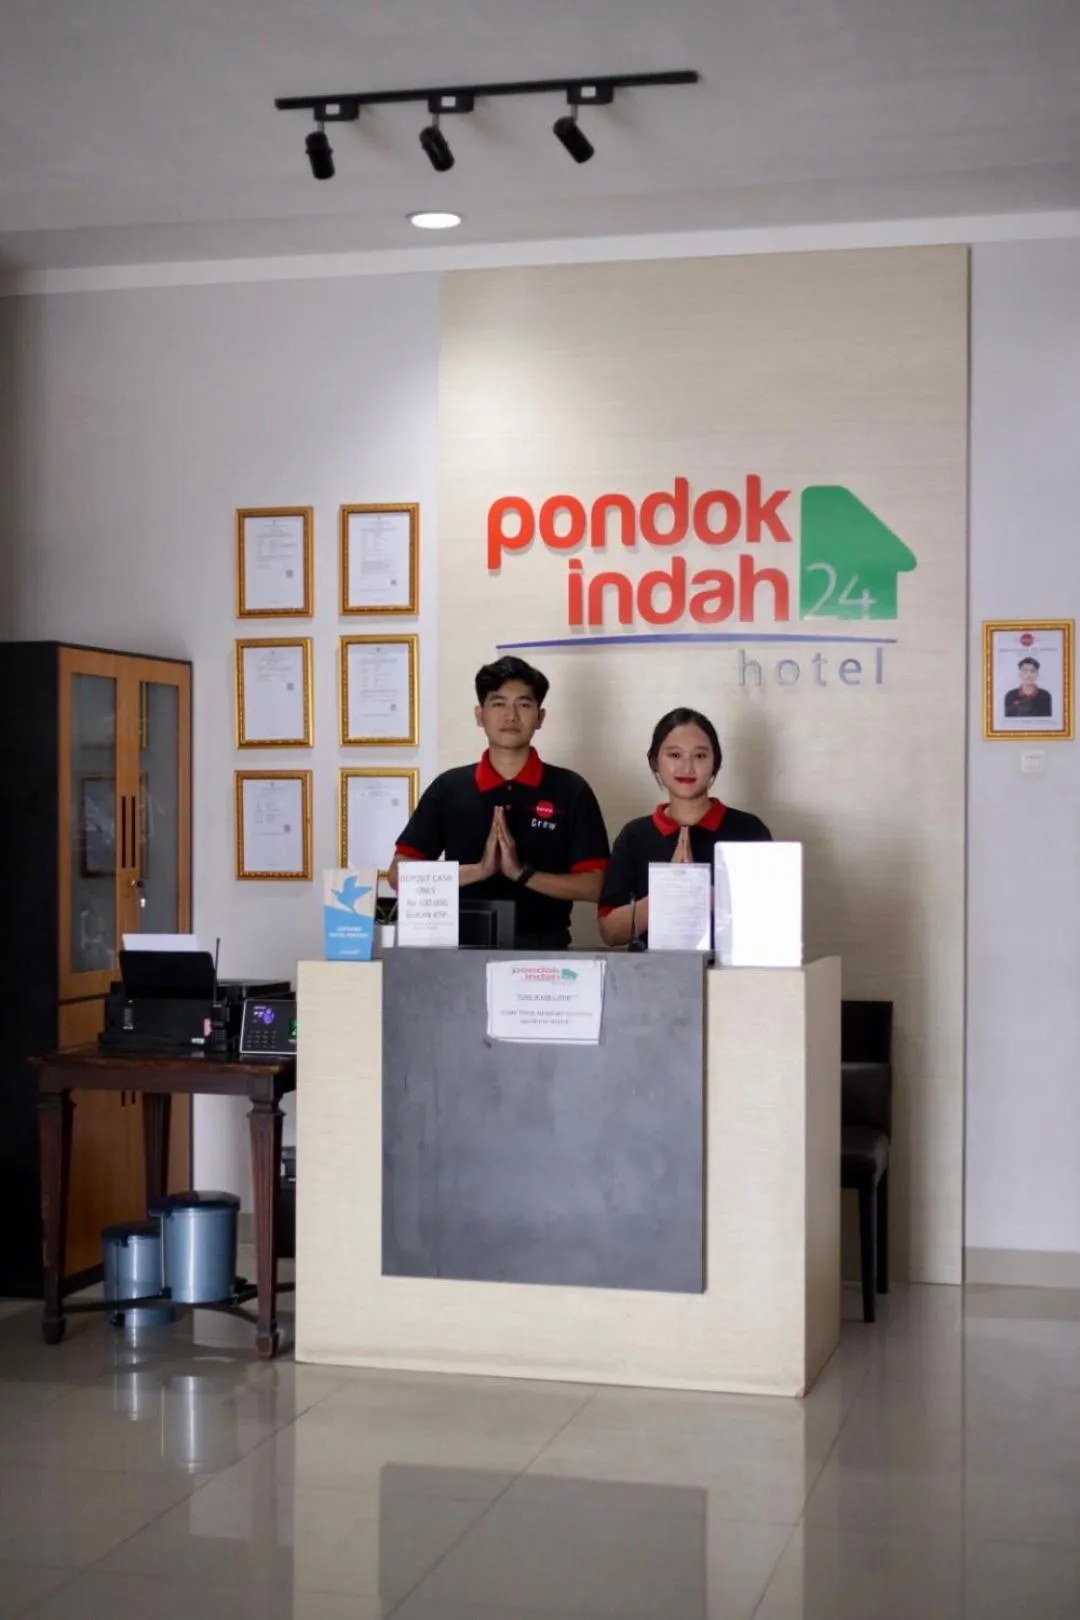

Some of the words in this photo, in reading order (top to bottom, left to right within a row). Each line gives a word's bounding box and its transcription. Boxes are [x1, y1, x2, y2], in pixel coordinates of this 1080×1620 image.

[487, 474, 793, 571] pondok
[567, 554, 790, 626] indah
[805, 562, 877, 621] 24
[737, 647, 884, 687] hotel
